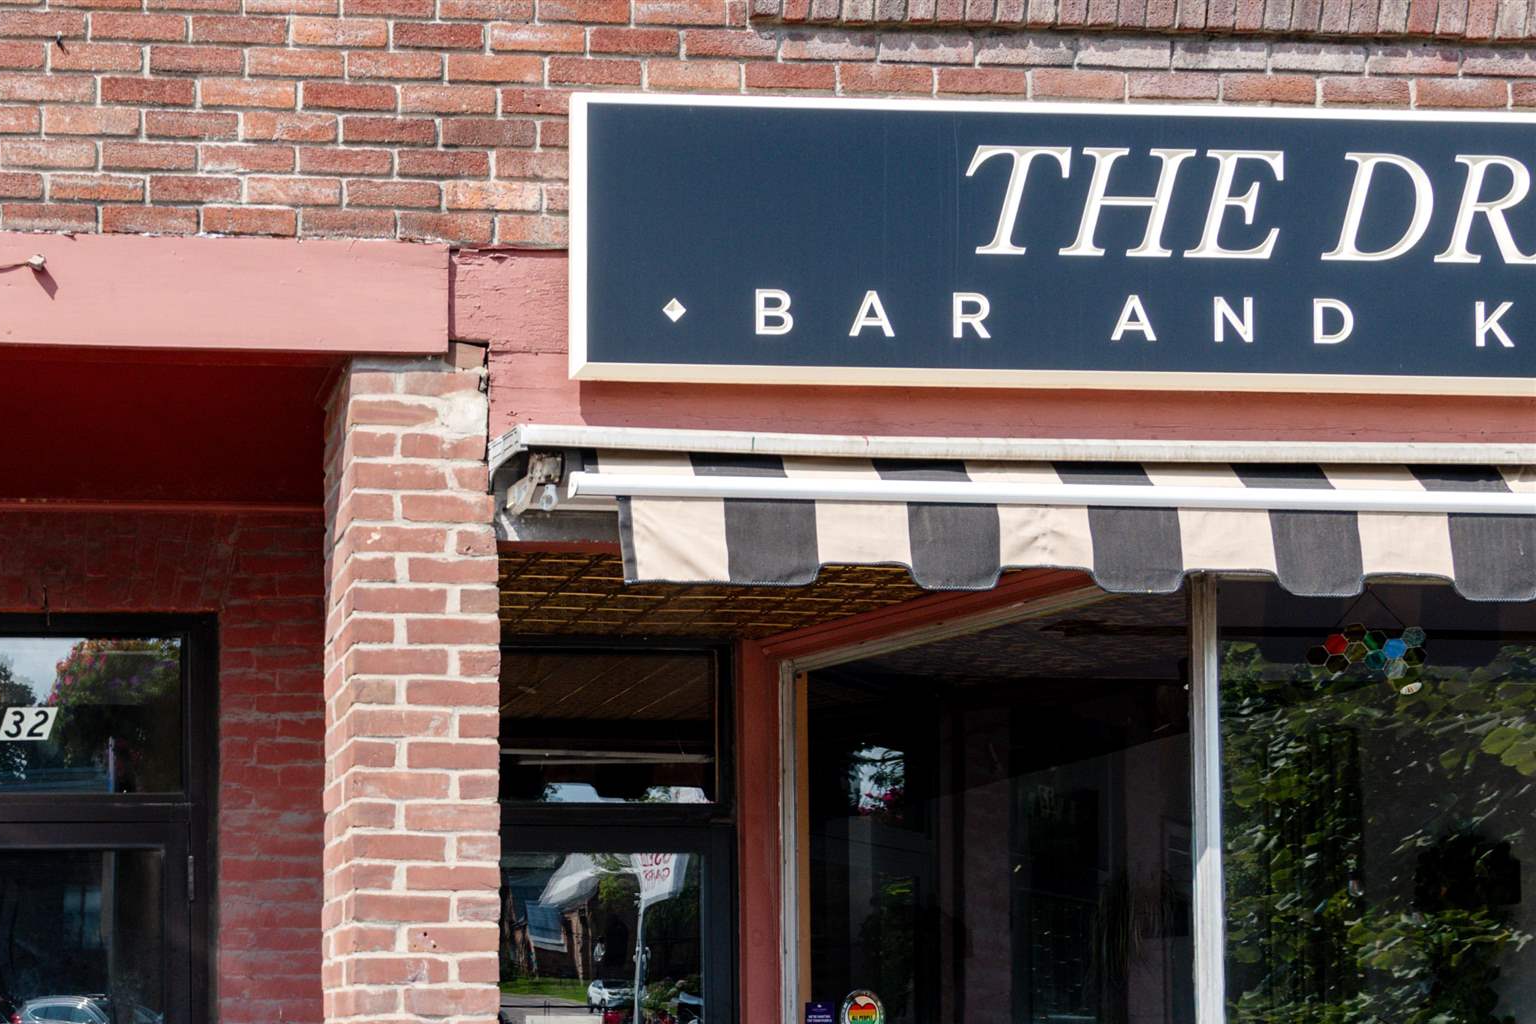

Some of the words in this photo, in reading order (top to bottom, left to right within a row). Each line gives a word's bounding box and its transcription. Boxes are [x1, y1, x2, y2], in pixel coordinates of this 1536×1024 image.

[965, 144, 1285, 260] THE
[1320, 151, 1536, 265] DR
[754, 287, 992, 339] BAR
[1110, 294, 1355, 345] AND
[1474, 300, 1516, 348] K
[4, 709, 50, 739] 32
